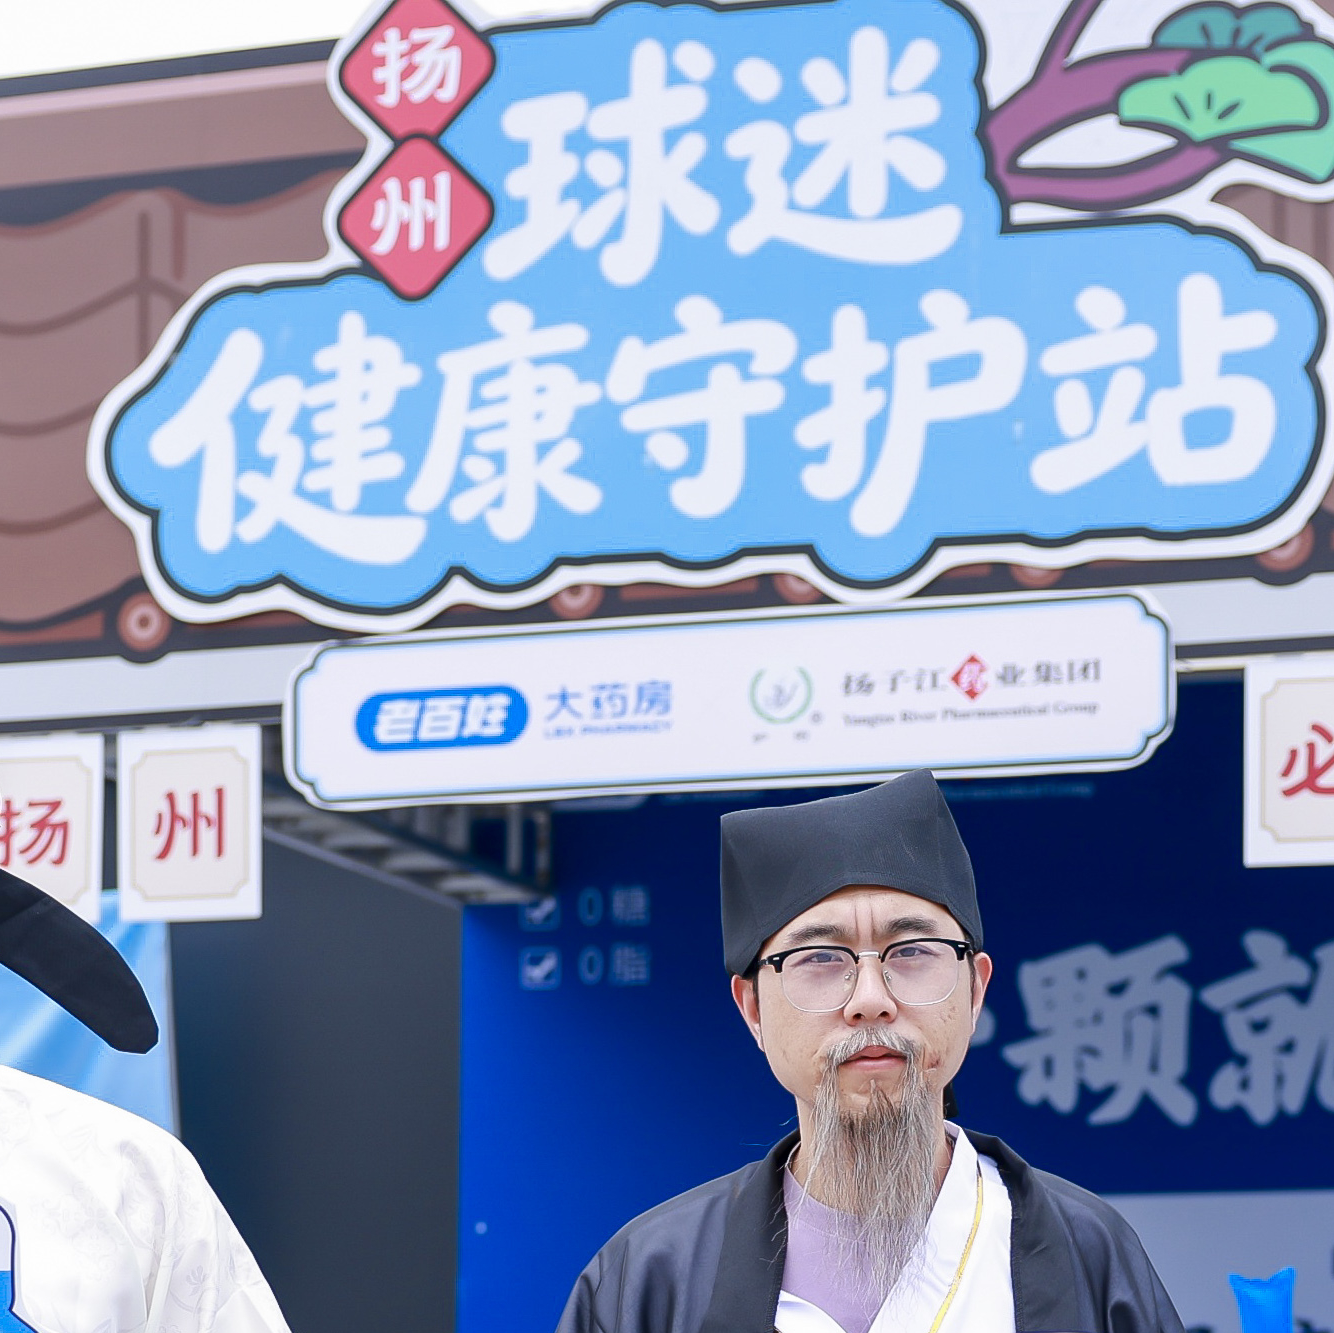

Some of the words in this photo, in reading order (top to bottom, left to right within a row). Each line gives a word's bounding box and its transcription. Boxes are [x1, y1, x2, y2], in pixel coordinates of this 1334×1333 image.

[369, 24, 464, 255] 扬州
[483, 24, 965, 288] 球迷
[148, 270, 1280, 567] 健康守护站
[373, 691, 512, 745] 老百姓
[543, 679, 674, 723] 大药房
